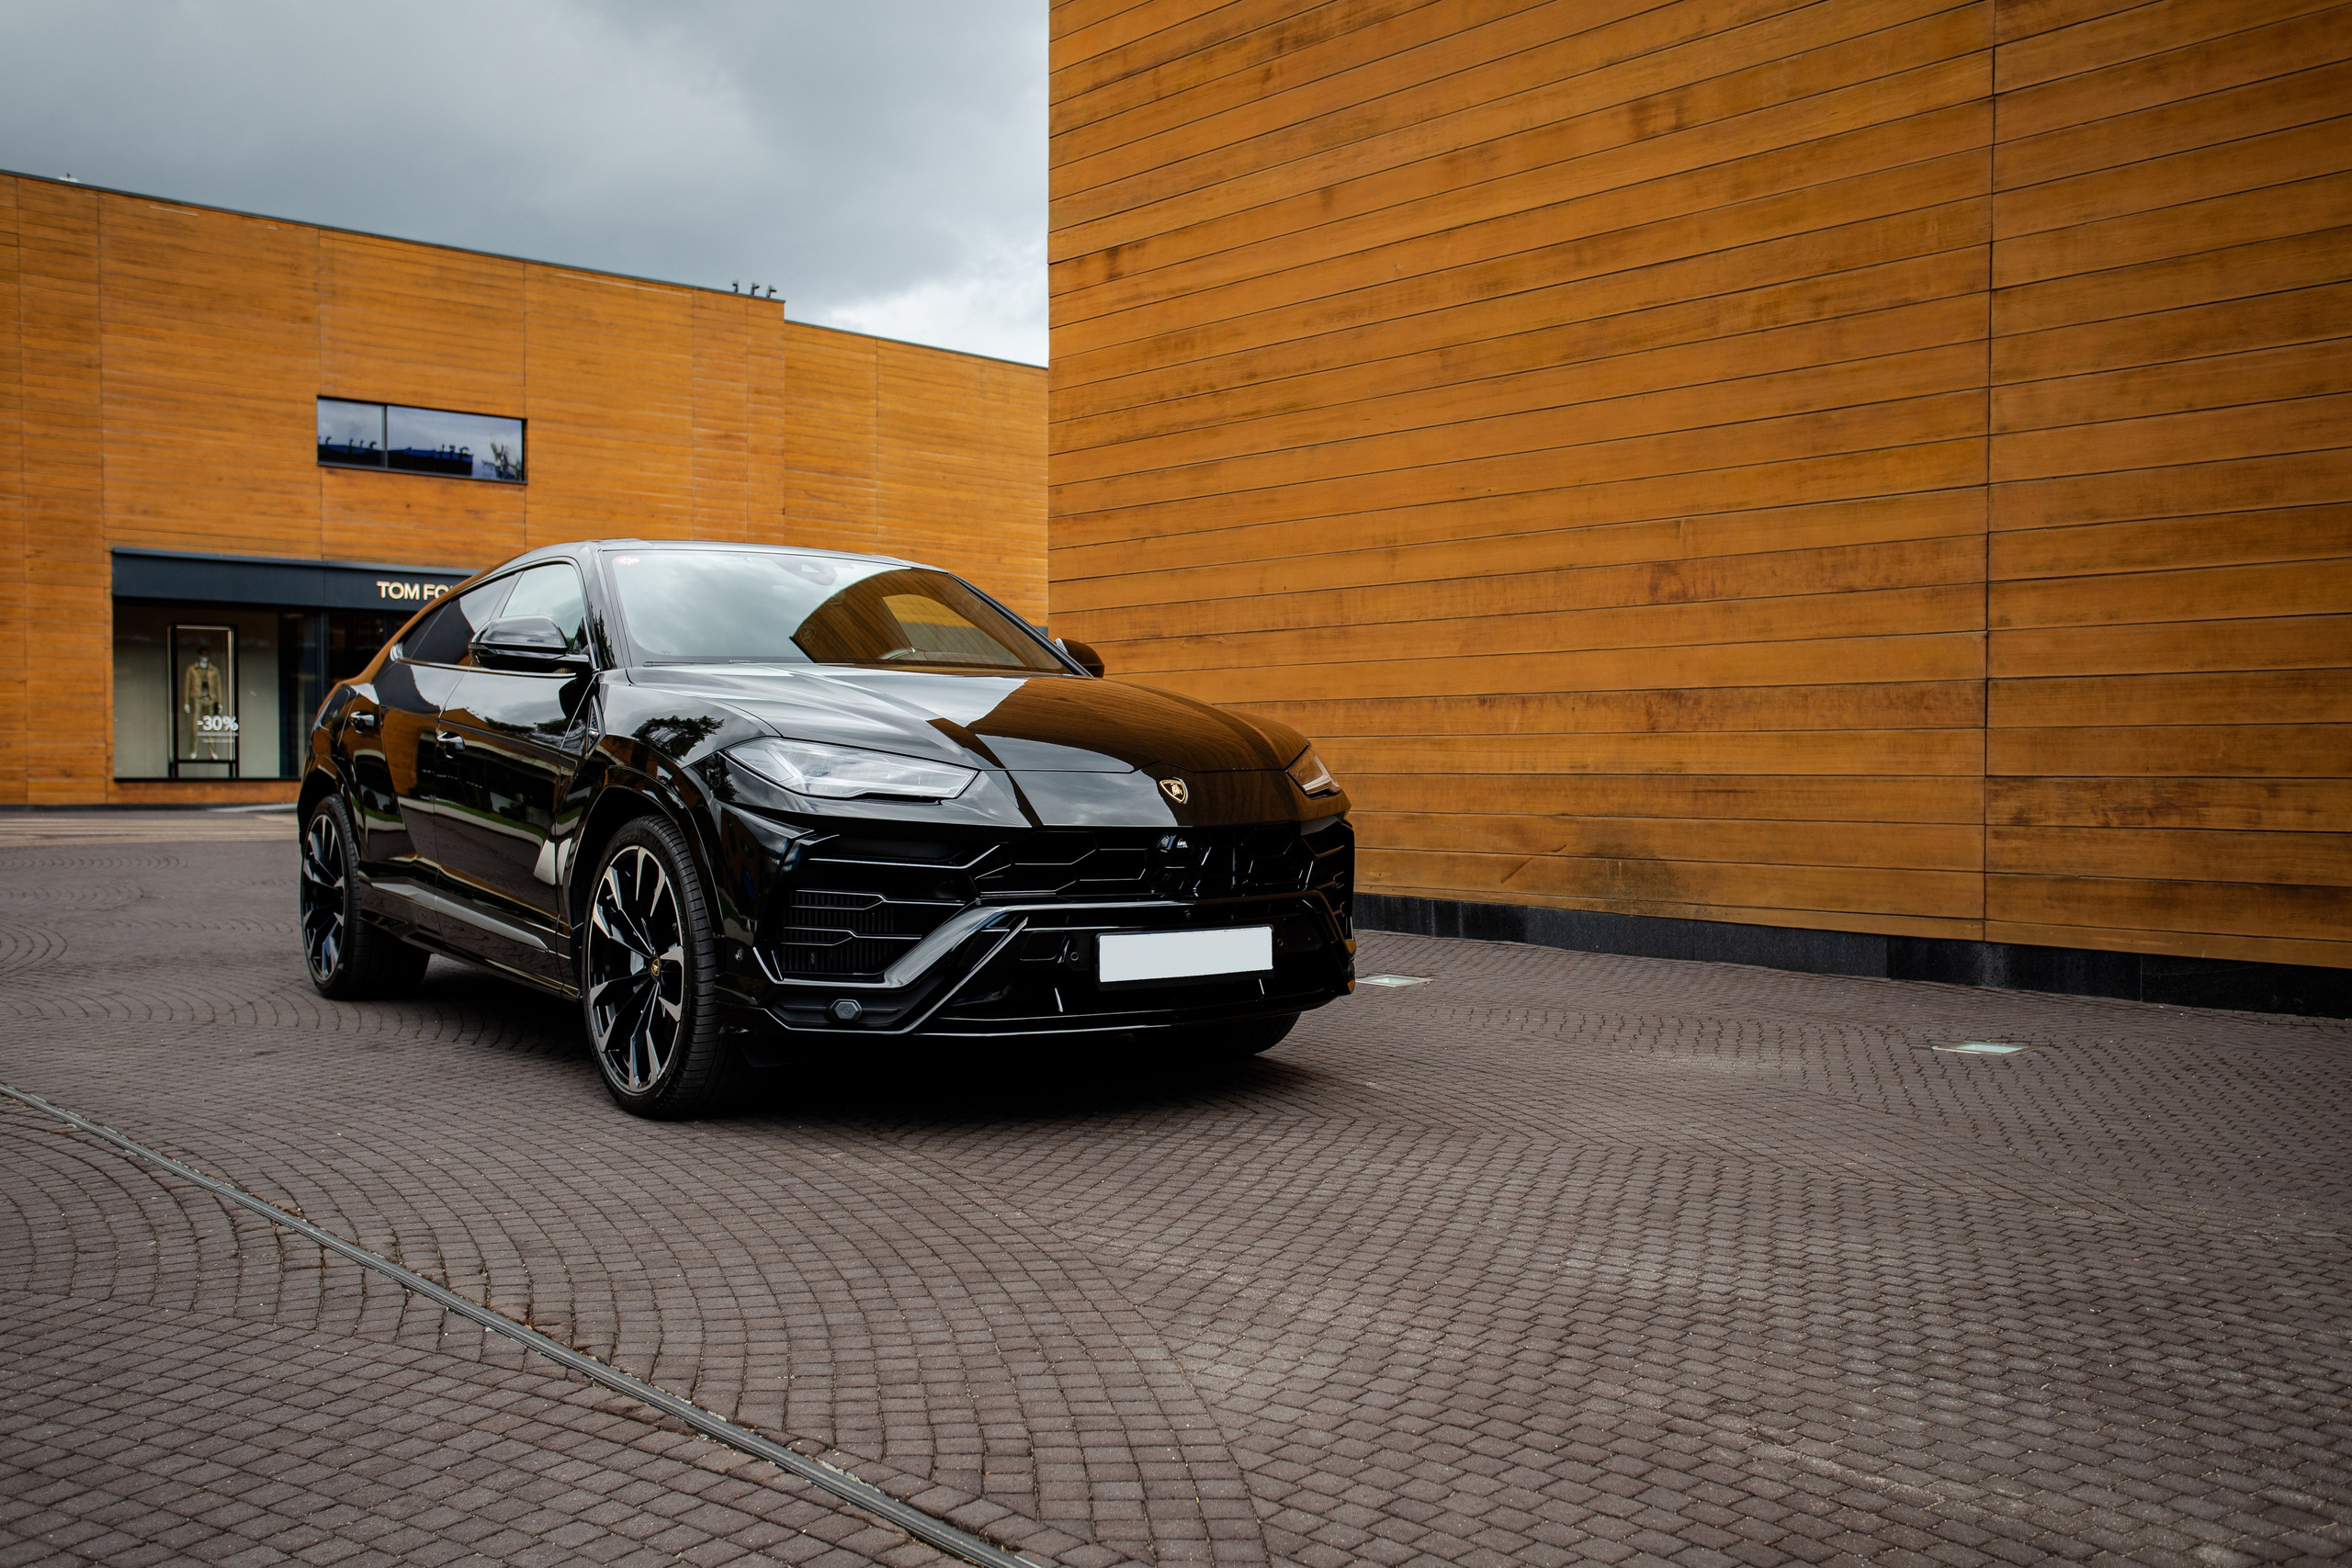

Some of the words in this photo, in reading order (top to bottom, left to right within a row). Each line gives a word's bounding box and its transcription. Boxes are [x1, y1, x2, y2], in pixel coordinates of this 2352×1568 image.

[376, 581, 420, 601] TOM
[423, 583, 454, 601] FO
[197, 715, 239, 731] -30%
